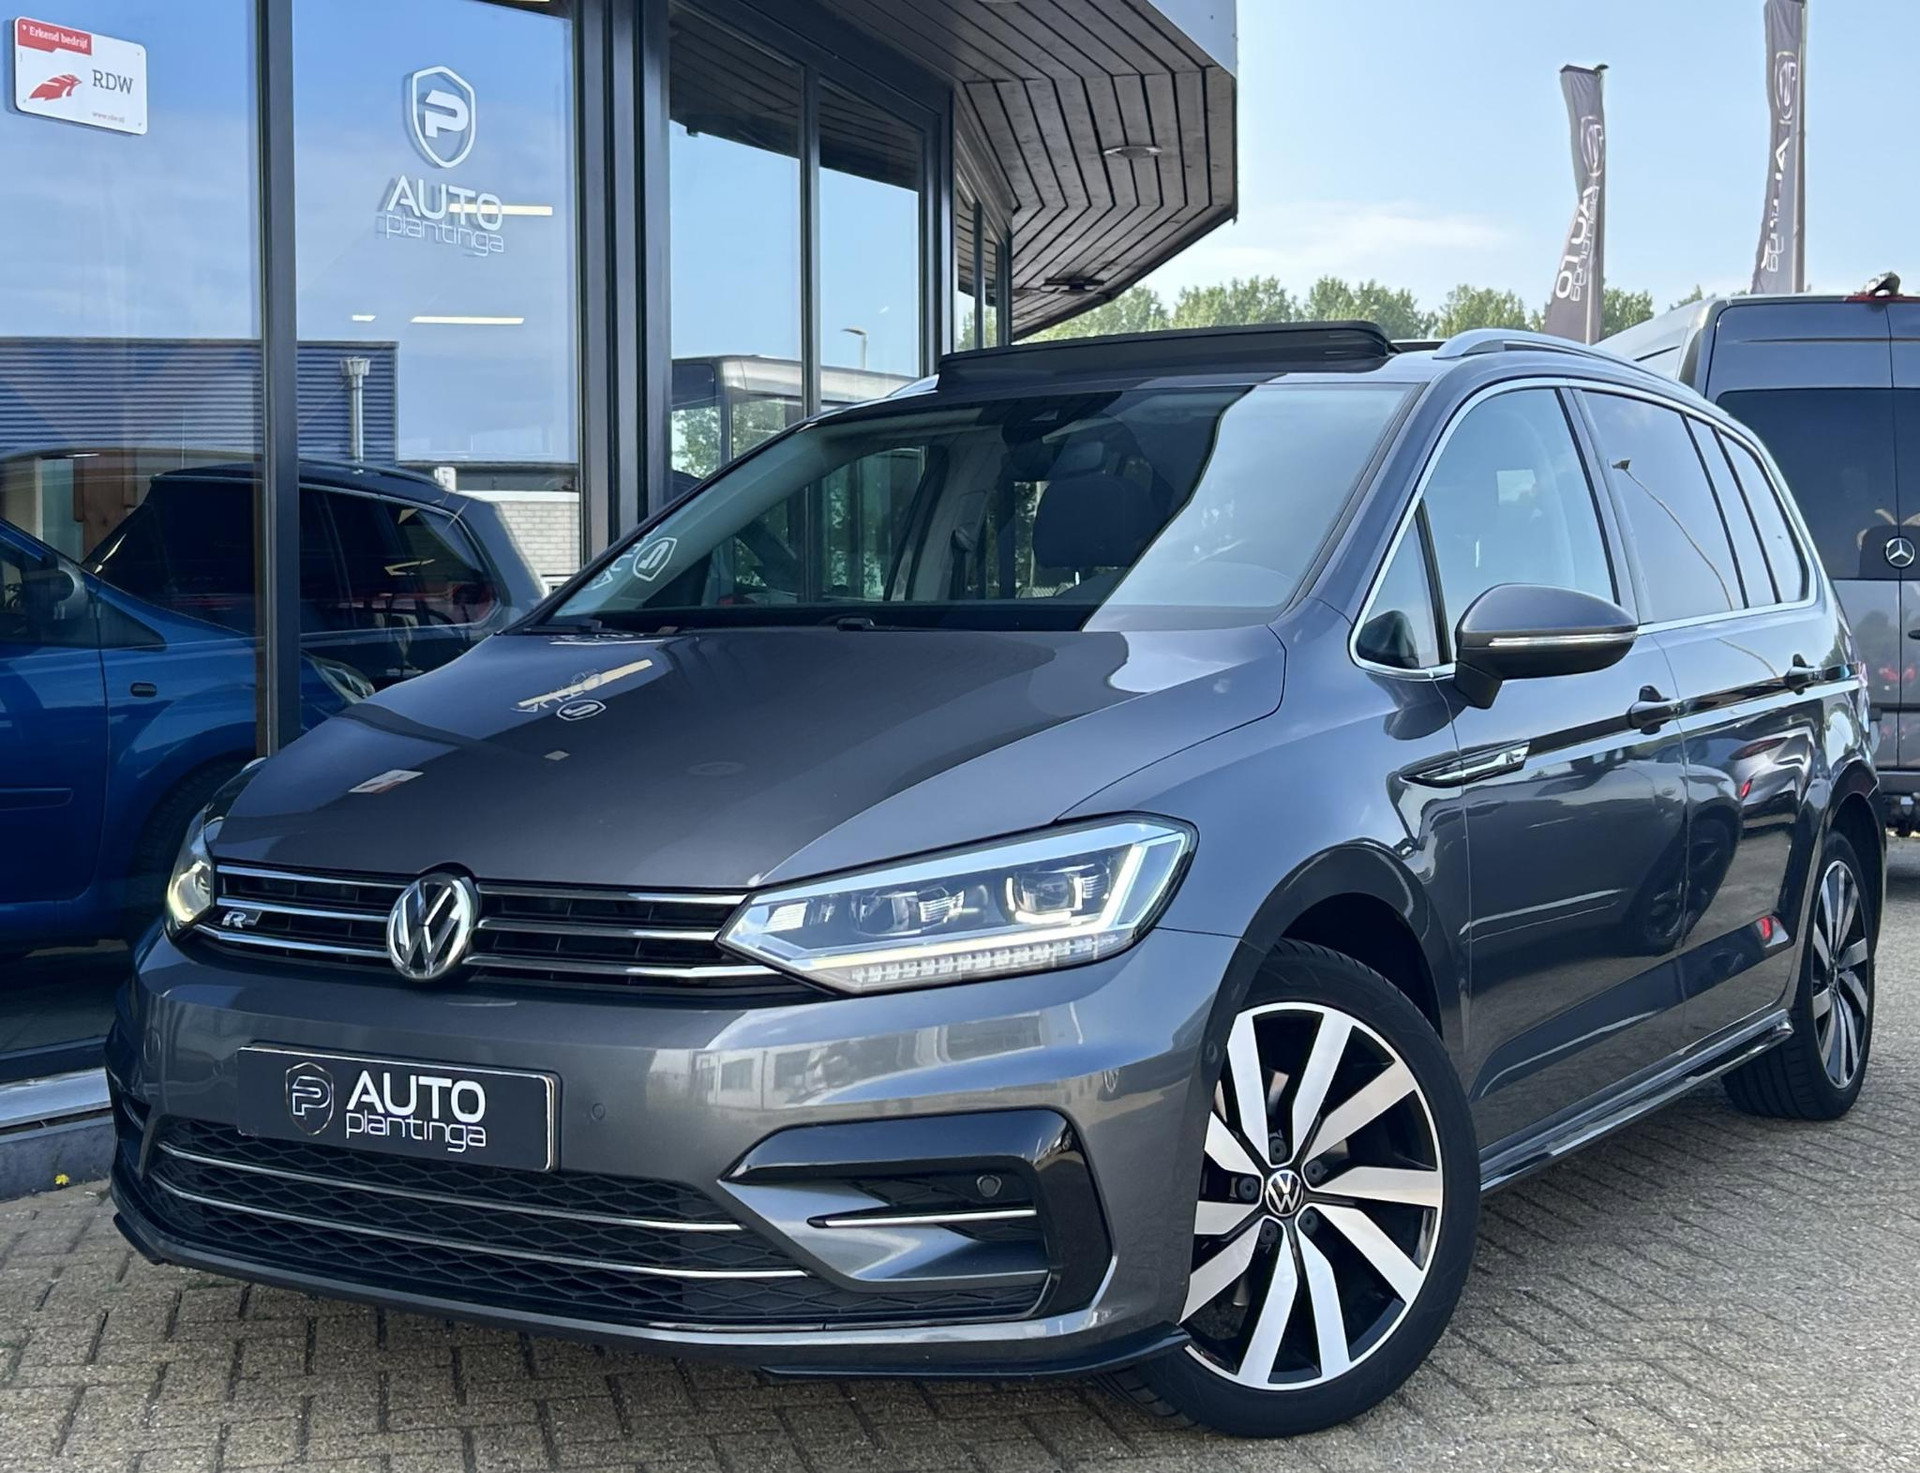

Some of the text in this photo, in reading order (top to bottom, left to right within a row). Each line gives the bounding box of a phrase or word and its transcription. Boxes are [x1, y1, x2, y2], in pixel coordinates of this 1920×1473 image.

[29, 26, 88, 49] Erkend bedrijf
[92, 69, 134, 95] RDW
[387, 174, 504, 231] AUTO
[386, 213, 505, 257] plantinga
[346, 1069, 487, 1124] AUTO
[345, 1109, 487, 1153] plantinga
